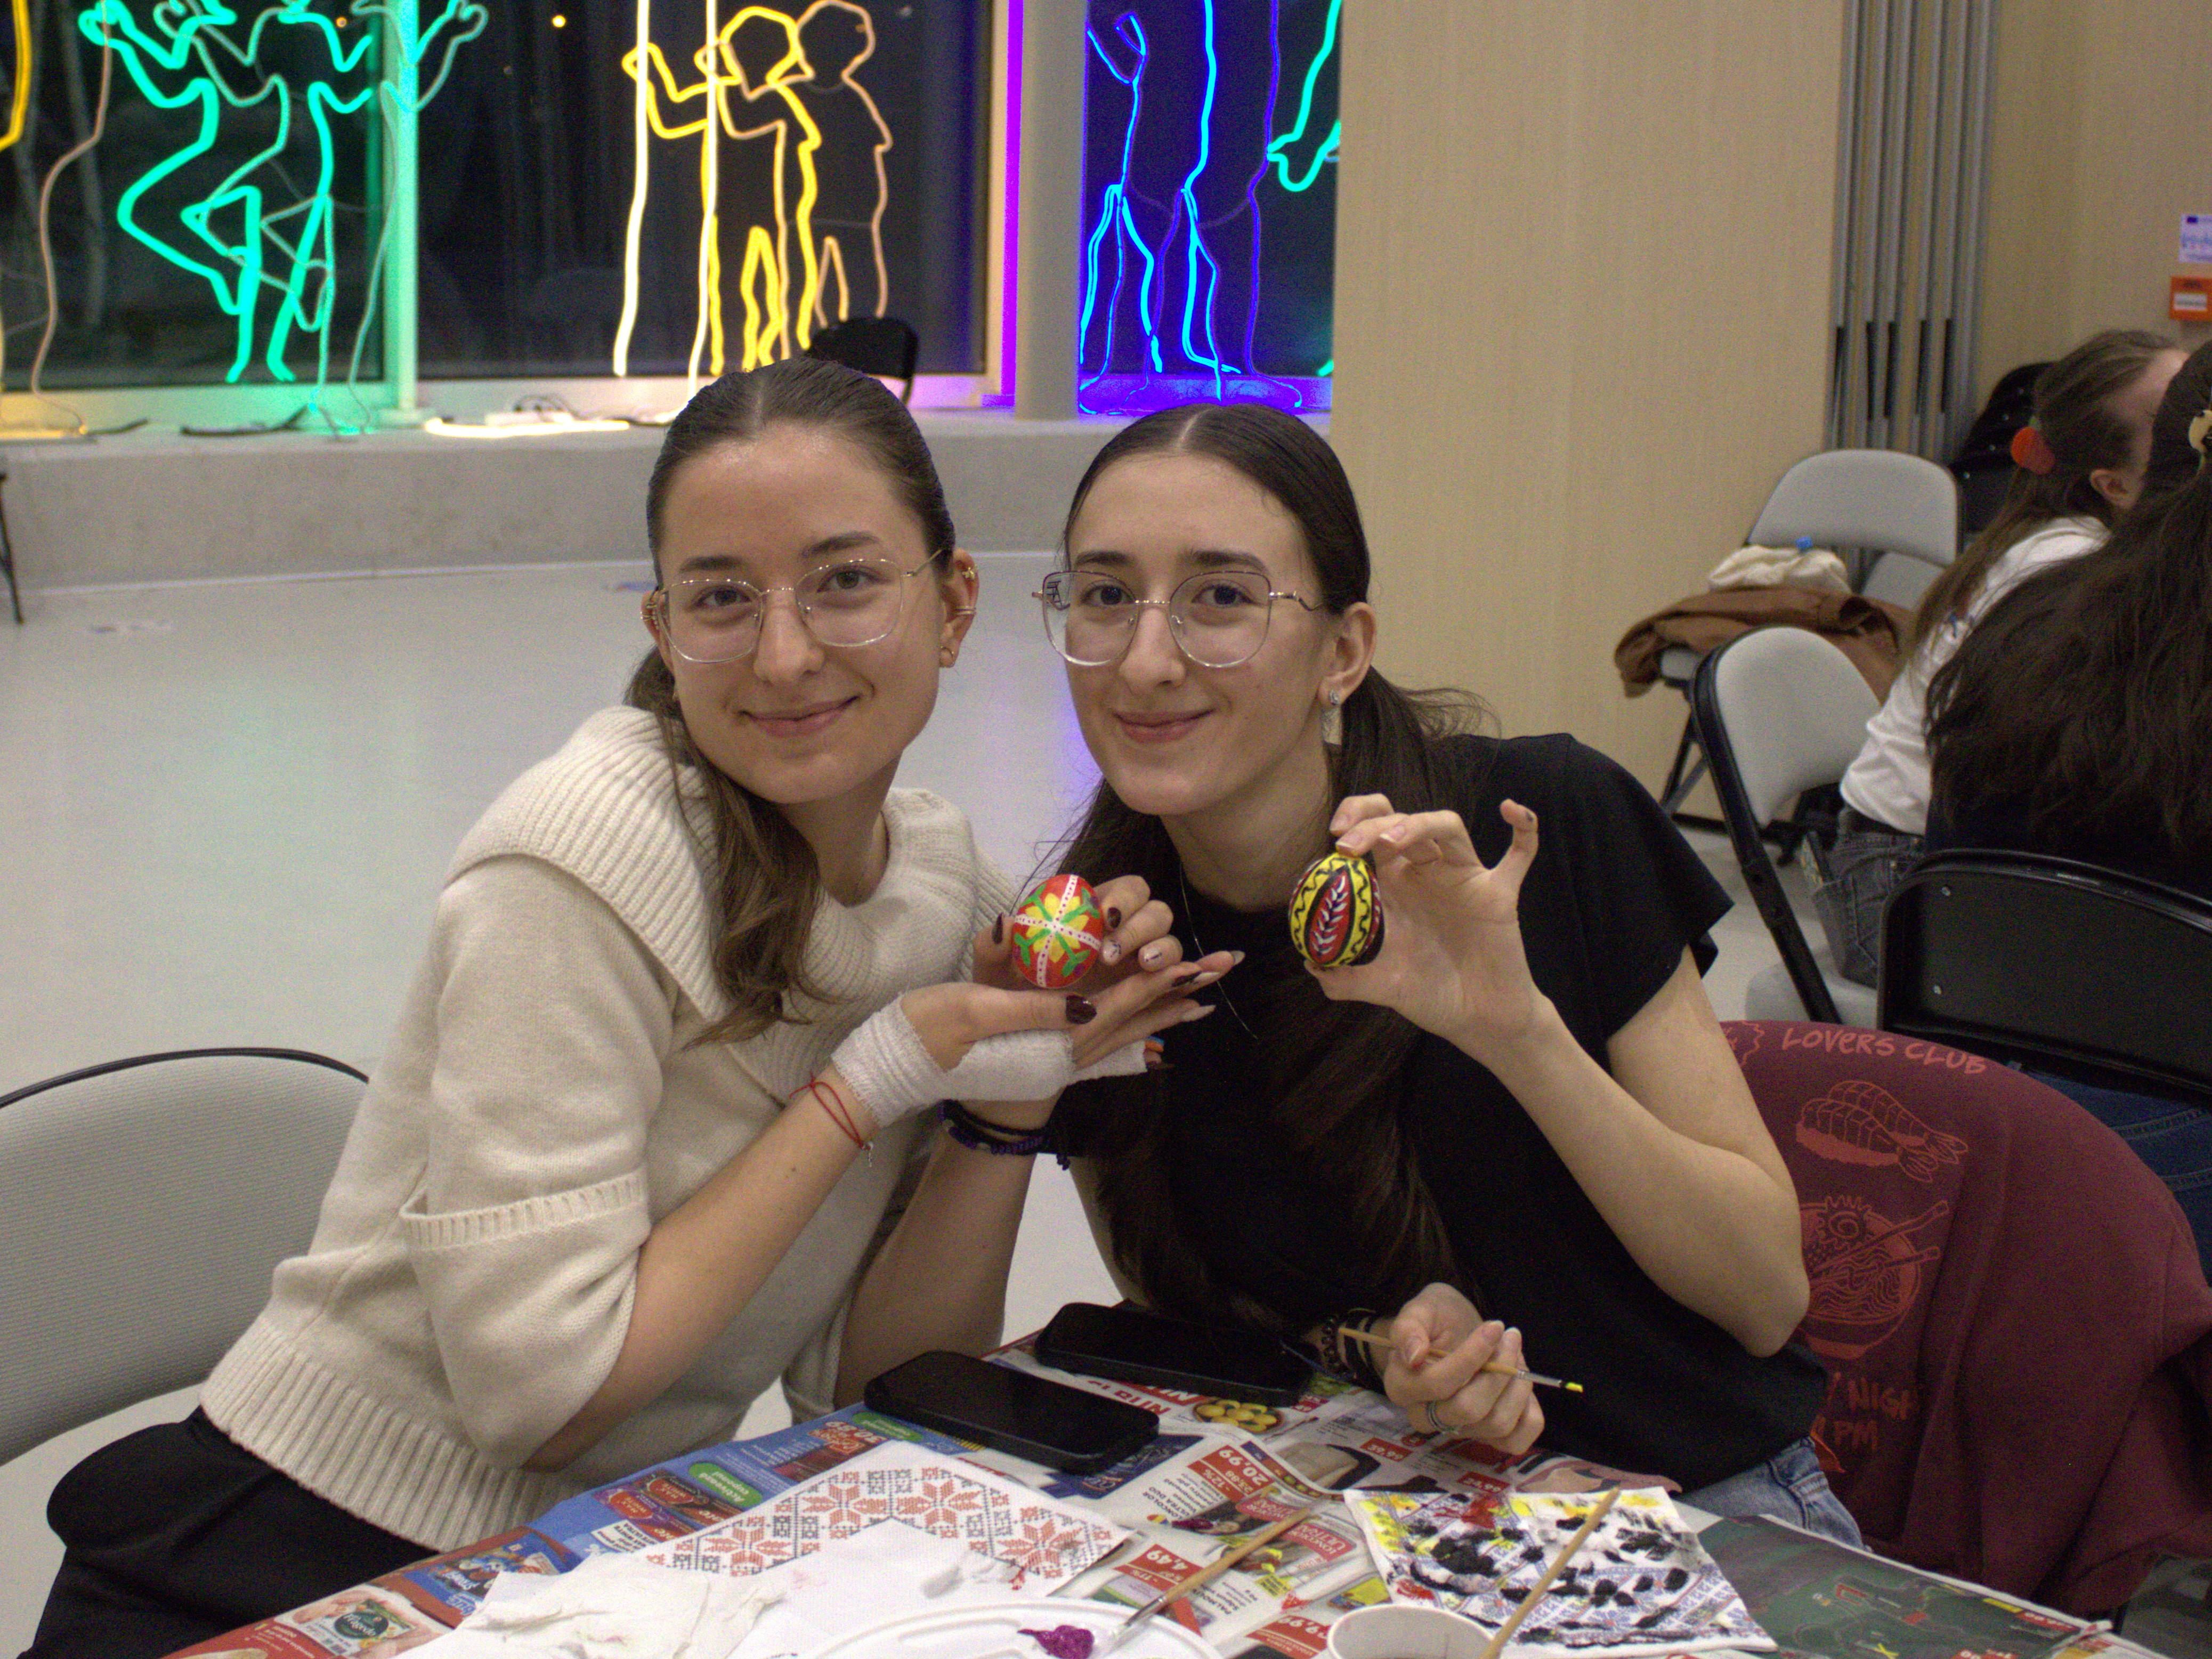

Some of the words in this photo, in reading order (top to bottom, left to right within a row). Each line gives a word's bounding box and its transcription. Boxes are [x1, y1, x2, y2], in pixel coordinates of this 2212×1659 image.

[1905, 1042, 1988, 1075] CLUB
[1218, 1448, 1269, 1485] 20,99
[1146, 1486, 1168, 1499] DUO
[1145, 1549, 1189, 1571] 4,49
